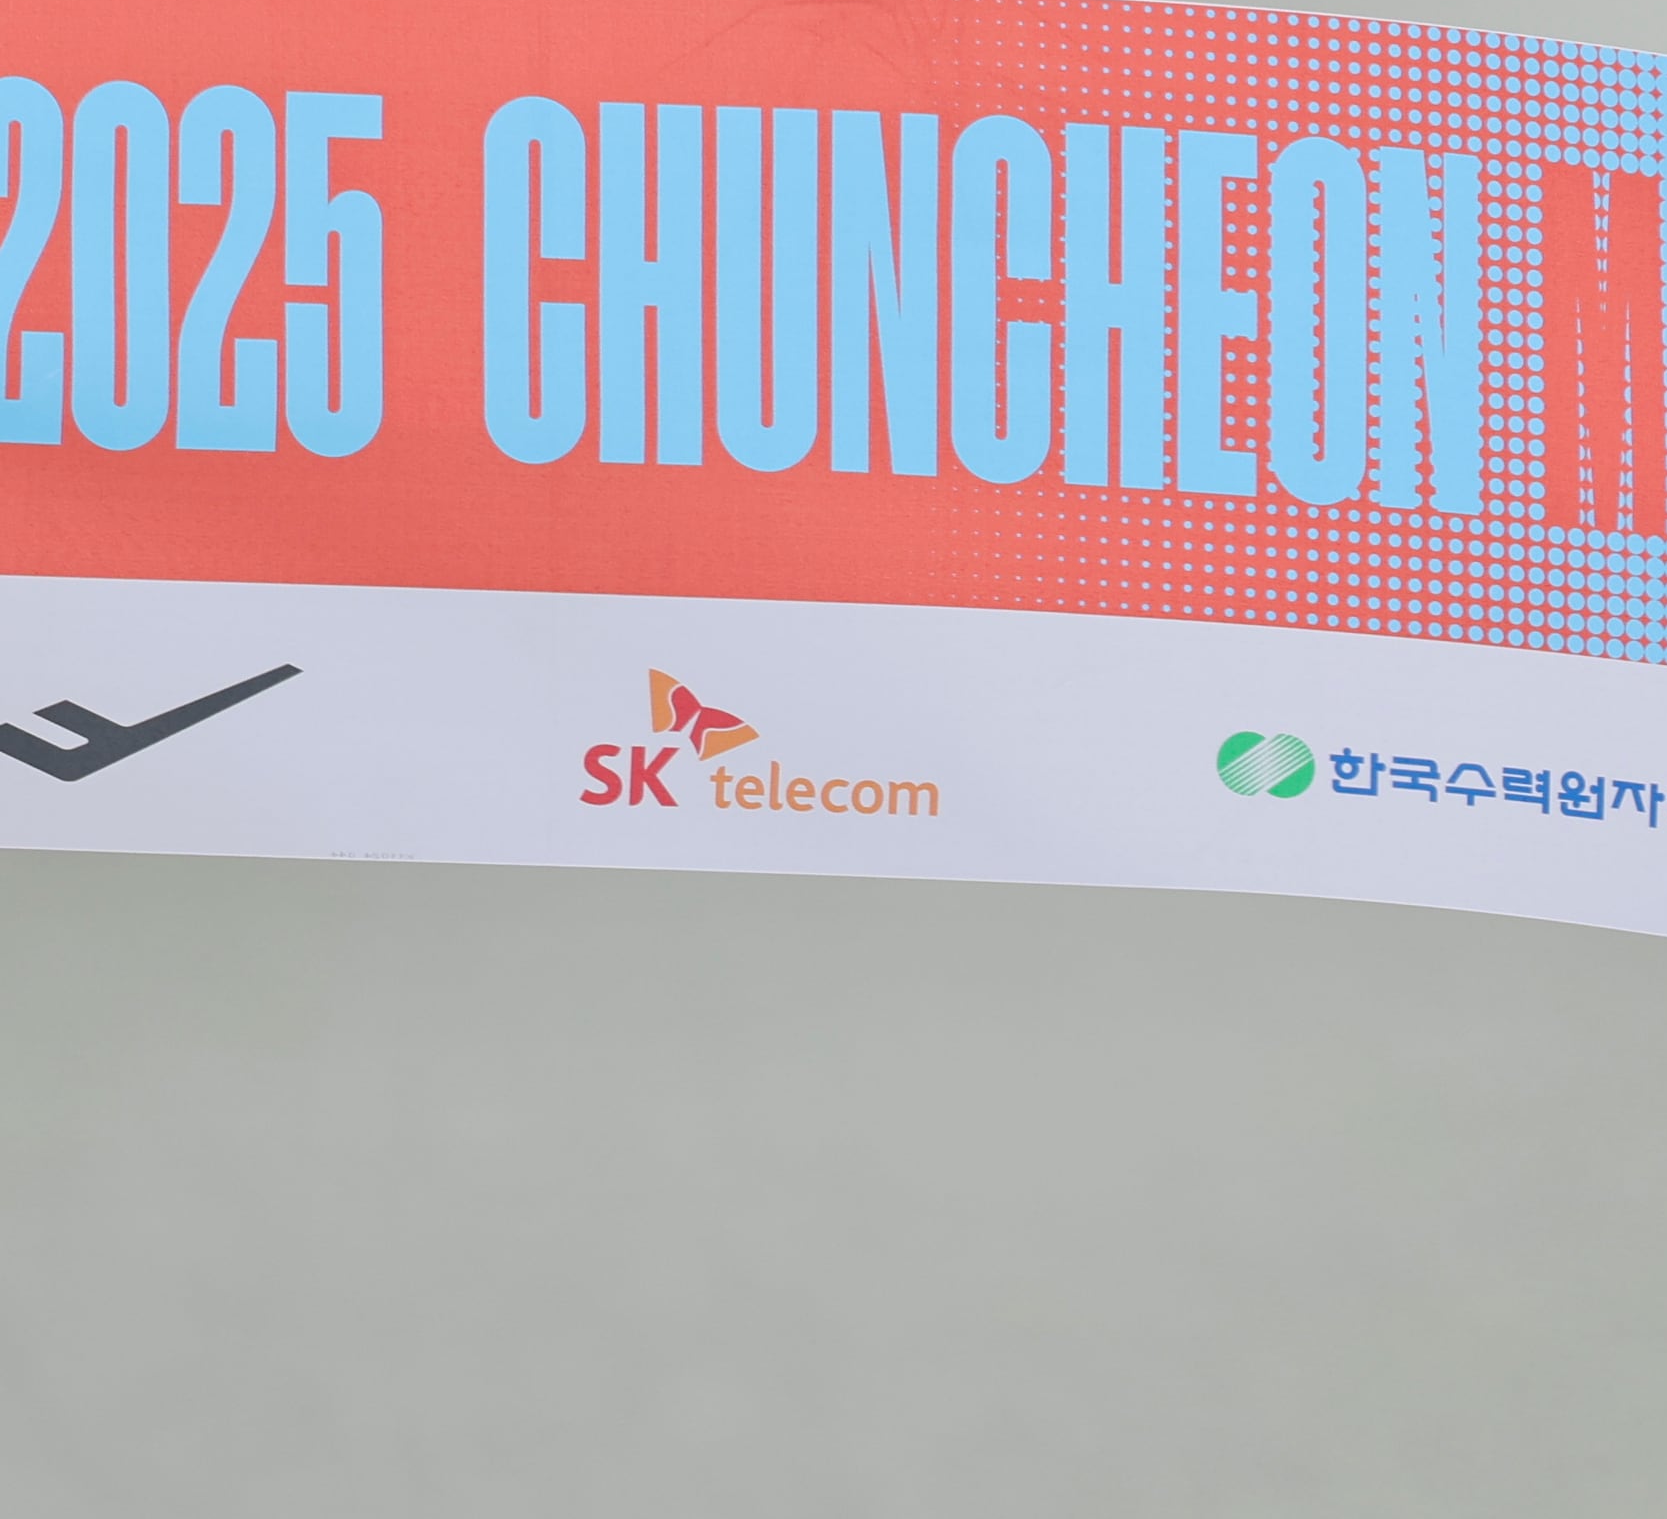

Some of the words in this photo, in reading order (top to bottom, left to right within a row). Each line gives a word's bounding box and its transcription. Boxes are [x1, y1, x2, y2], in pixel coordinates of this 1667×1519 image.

[0, 75, 383, 458] 2025
[483, 95, 1482, 516] CHUNCHEON
[579, 743, 681, 808] SK
[709, 760, 940, 817] telecom
